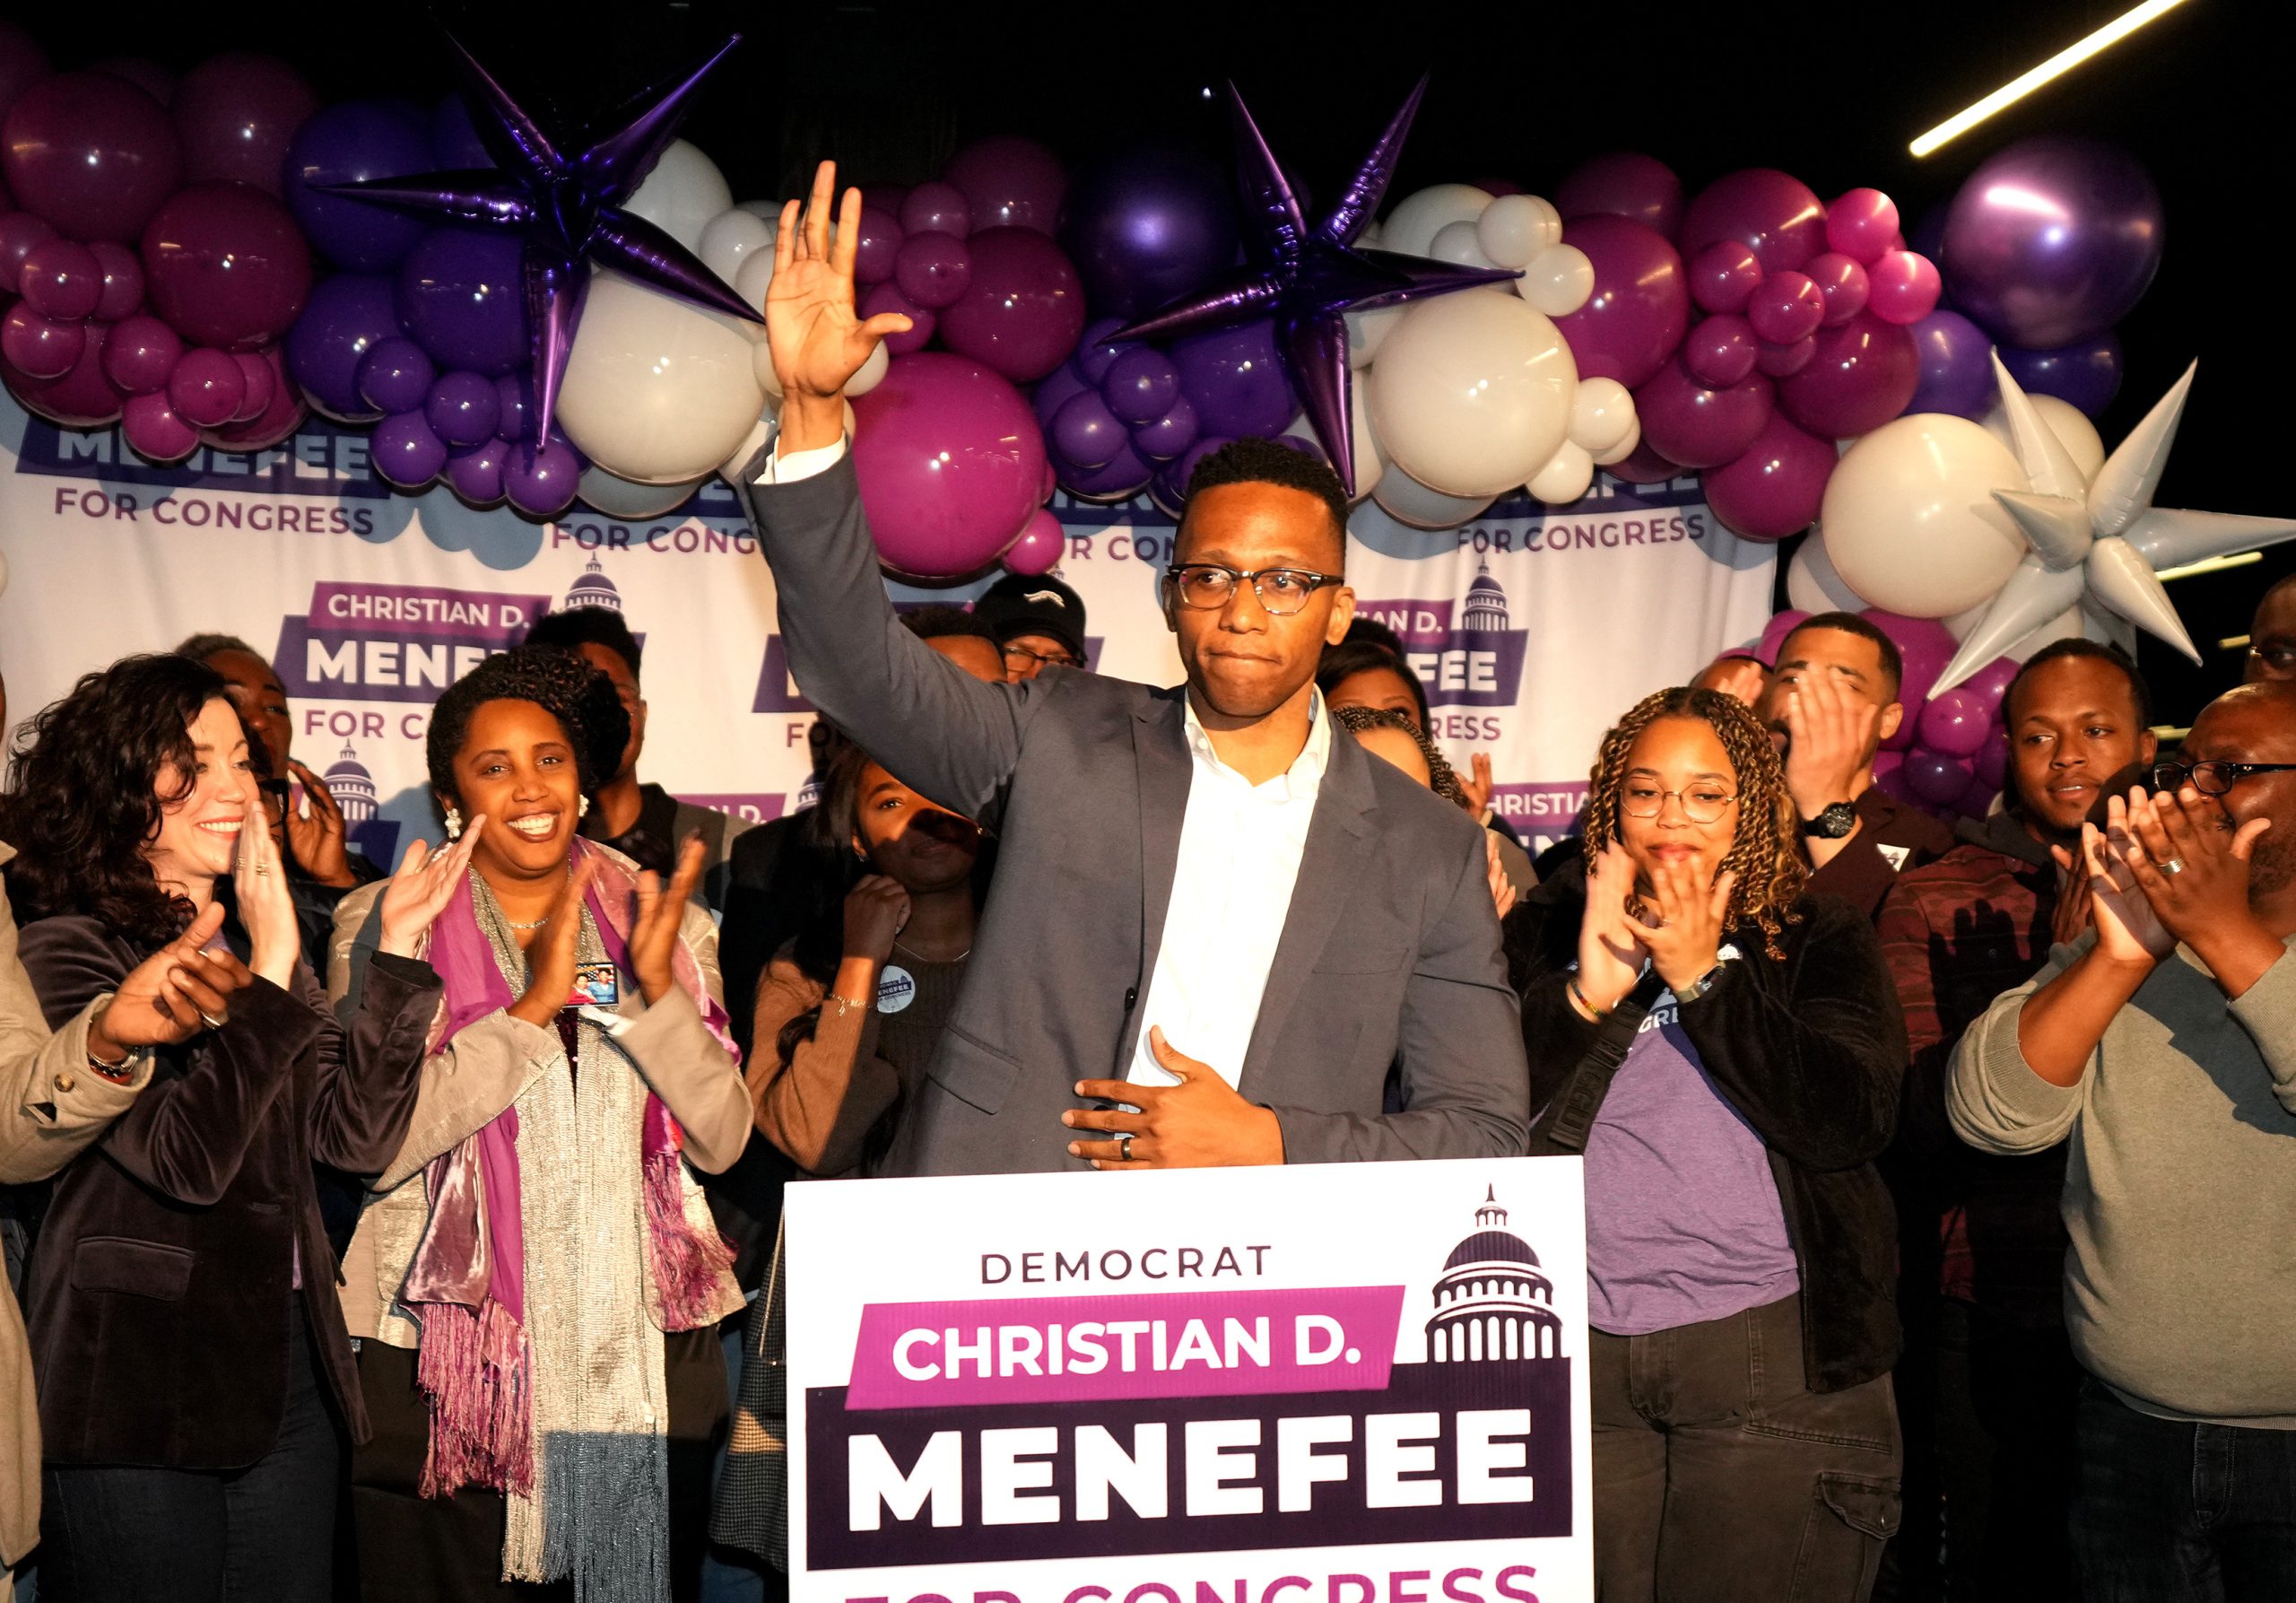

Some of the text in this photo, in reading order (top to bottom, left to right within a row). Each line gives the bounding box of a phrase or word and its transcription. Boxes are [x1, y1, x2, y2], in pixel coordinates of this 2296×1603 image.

[55, 487, 374, 536] FOR CONGRESS
[552, 523, 756, 554] FOR CONG
[1458, 514, 1705, 553] FOR CONGRESS
[327, 594, 531, 629] CHRISTIAN D.
[1415, 611, 1443, 632] D.
[304, 709, 386, 738] FOR
[980, 1245, 1273, 1285] DEMOCRAT
[894, 1314, 1361, 1381] CHRISTIAN D.
[848, 1408, 1535, 1532] MENEFEE
